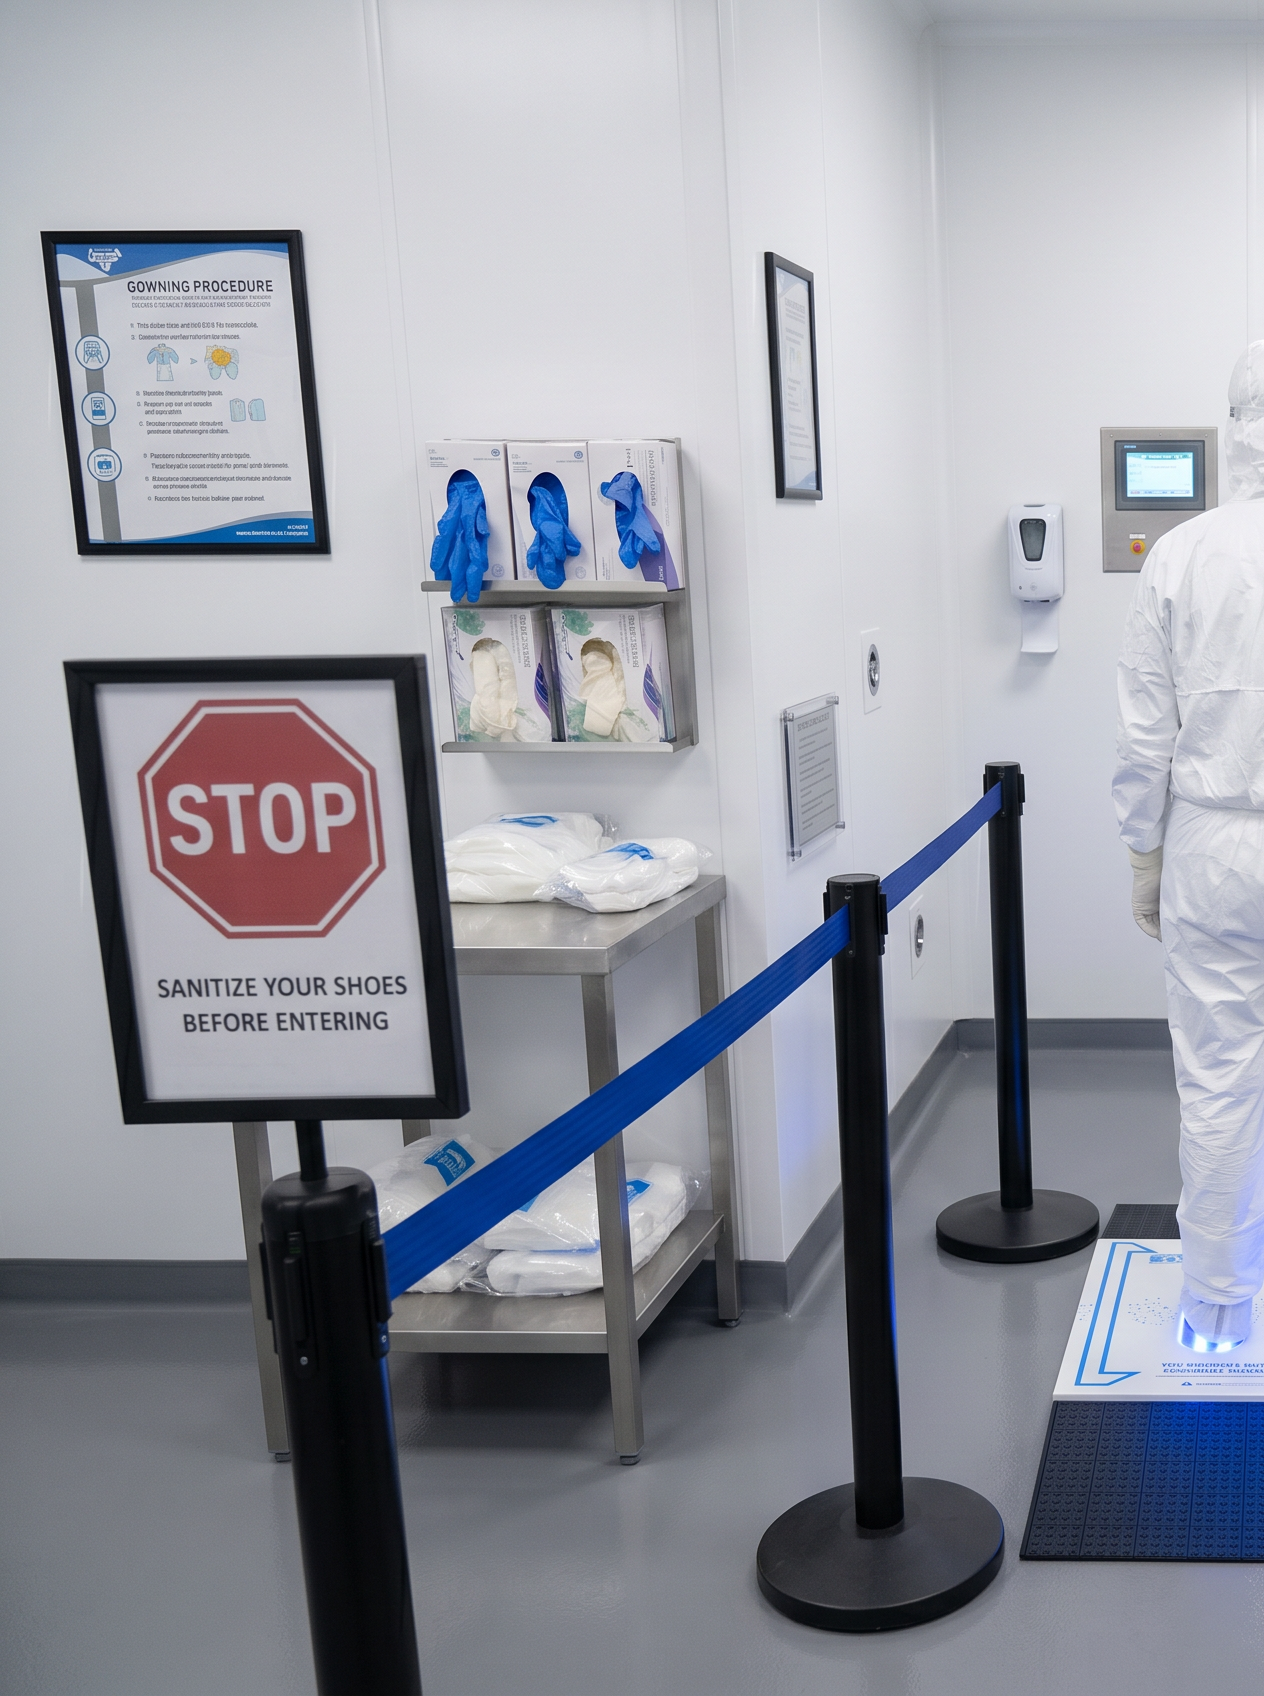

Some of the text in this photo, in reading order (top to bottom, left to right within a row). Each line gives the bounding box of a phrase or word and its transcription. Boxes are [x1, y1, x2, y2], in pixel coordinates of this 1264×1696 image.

[127, 279, 273, 293] GOWNING PROCEDURE
[167, 782, 357, 856] STOP
[157, 975, 408, 998] SANITIZE YOUR SHOES
[183, 1010, 389, 1033] BEFORE ENTERING
